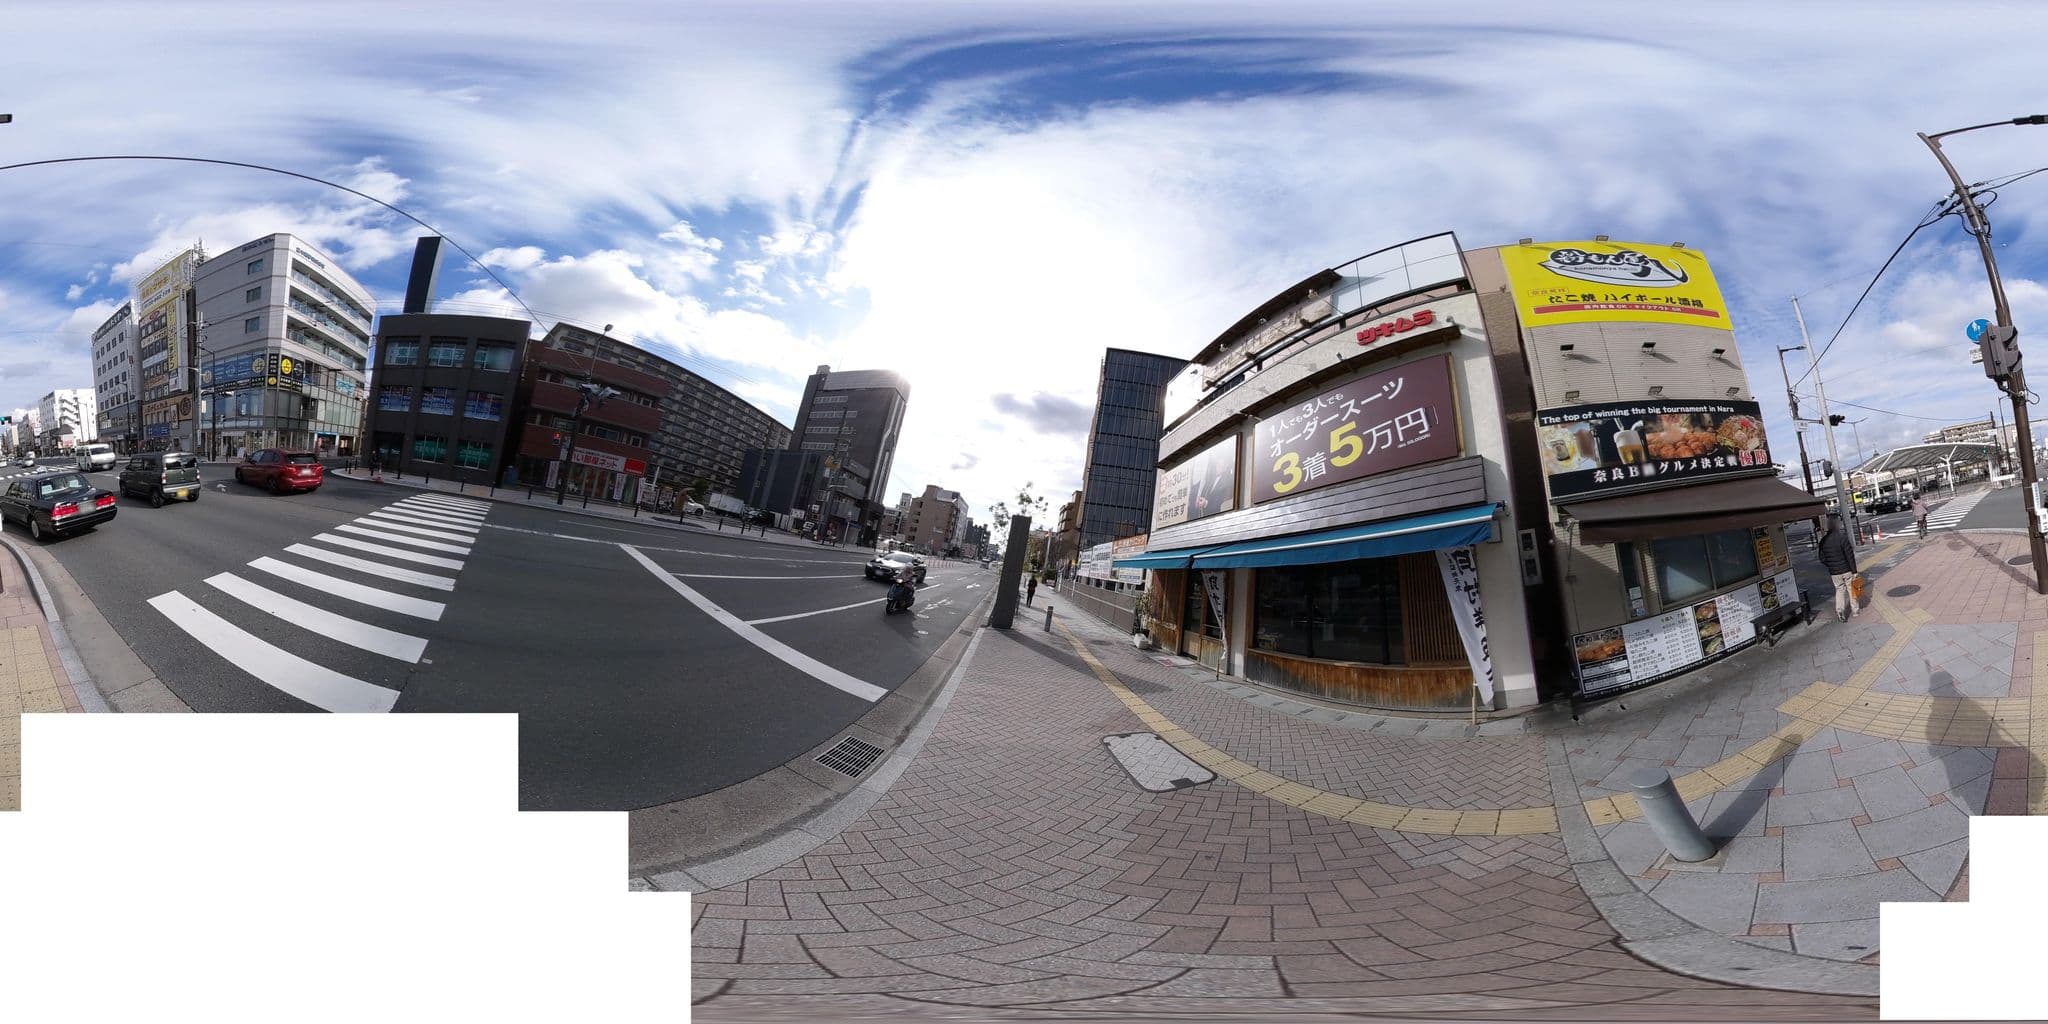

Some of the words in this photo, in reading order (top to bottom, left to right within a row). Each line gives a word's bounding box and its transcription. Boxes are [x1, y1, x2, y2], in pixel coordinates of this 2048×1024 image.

[1549, 293, 1597, 303] たこ焼
[1356, 309, 1433, 346] ツキムラ
[1269, 393, 1344, 437] 1人でも3人でも
[1270, 377, 1404, 458] オーダースーツ
[1542, 415, 1561, 424] The
[1563, 413, 1580, 423] top
[1582, 411, 1593, 419] of
[1595, 408, 1630, 418] winning
[1632, 407, 1646, 415] the
[1648, 406, 1661, 415] big
[1662, 405, 1708, 413] tournament
[1708, 405, 1716, 413] in
[1717, 405, 1735, 413] Nara
[1272, 407, 1430, 494] 3着5万円
